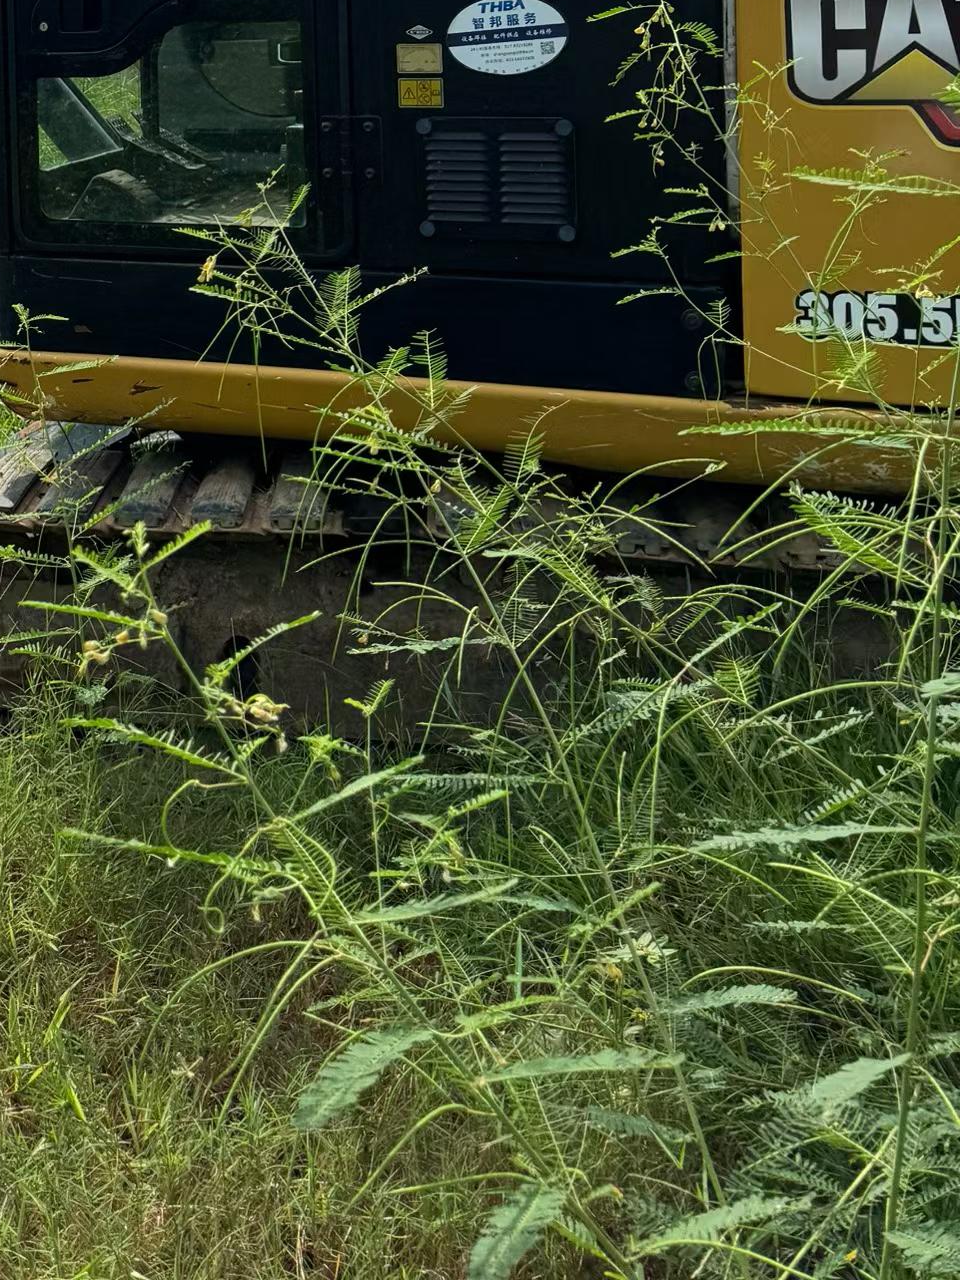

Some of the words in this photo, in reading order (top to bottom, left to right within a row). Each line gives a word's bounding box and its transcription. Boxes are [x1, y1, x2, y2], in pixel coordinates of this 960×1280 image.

[471, 12, 537, 30] 智邦服务
[796, 290, 960, 344] 305.5
